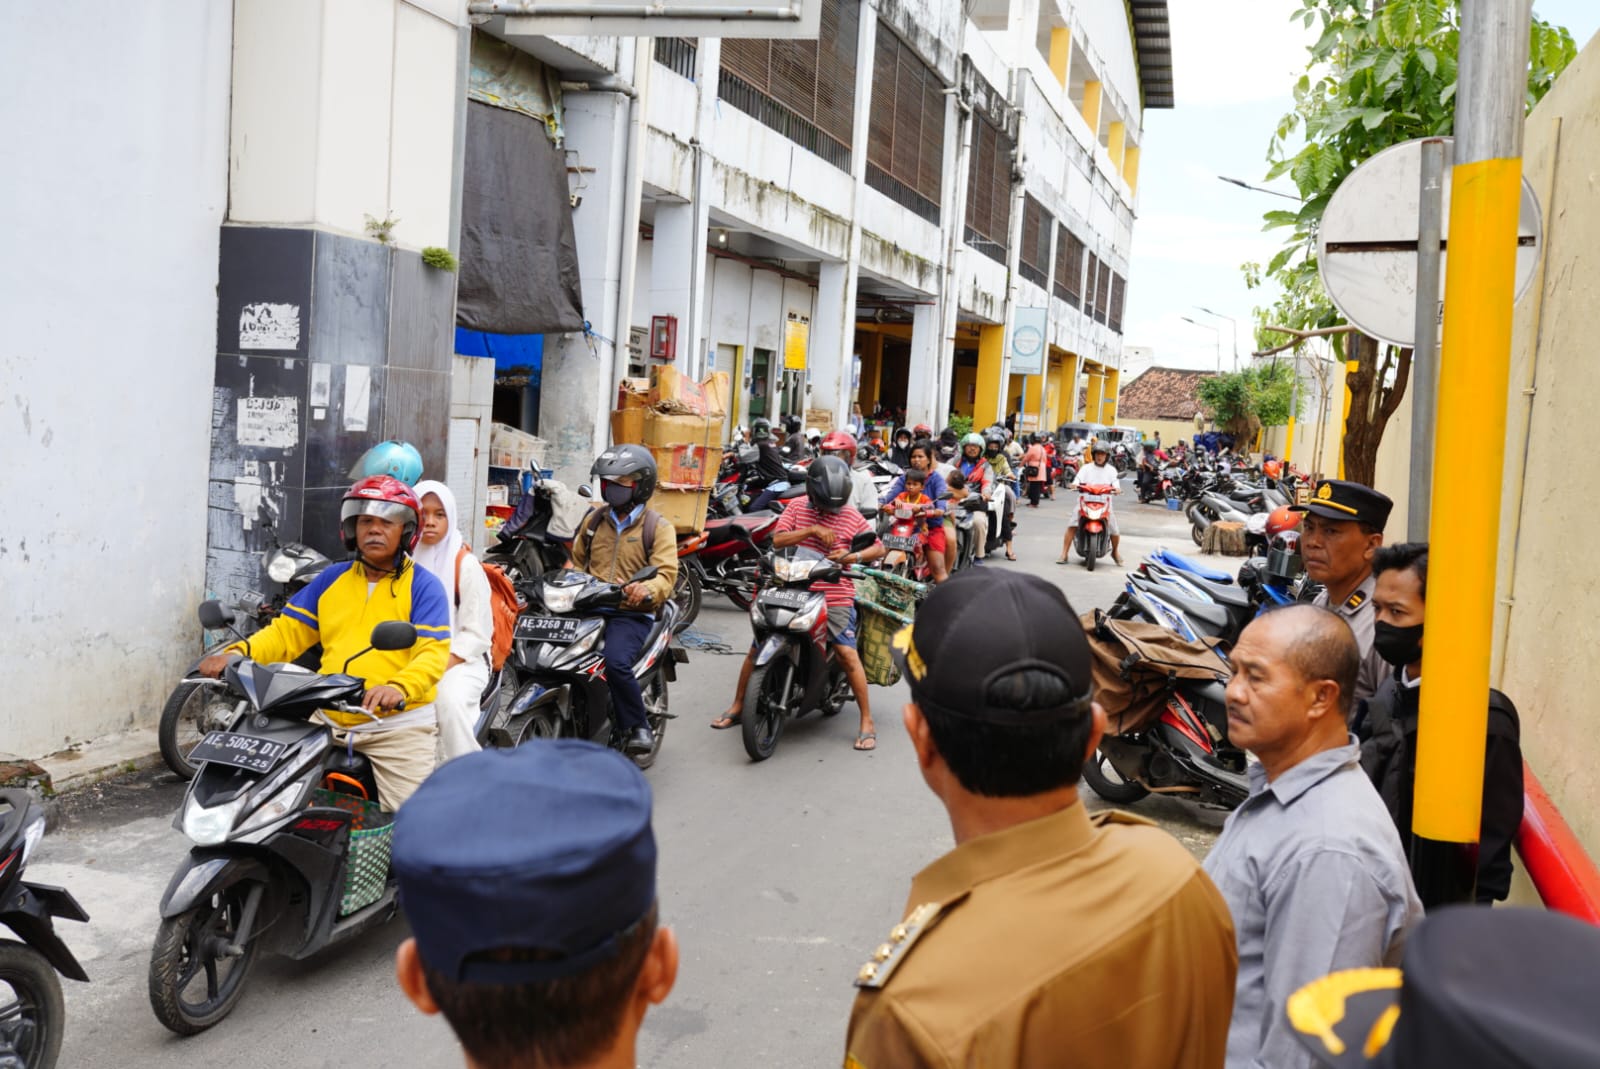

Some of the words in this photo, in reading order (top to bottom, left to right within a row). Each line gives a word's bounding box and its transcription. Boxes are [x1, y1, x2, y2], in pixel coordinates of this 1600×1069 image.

[521, 618, 535, 629] AE
[563, 620, 576, 631] HL
[203, 733, 225, 746] AE
[225, 735, 260, 751] 5062
[259, 742, 281, 757] DI
